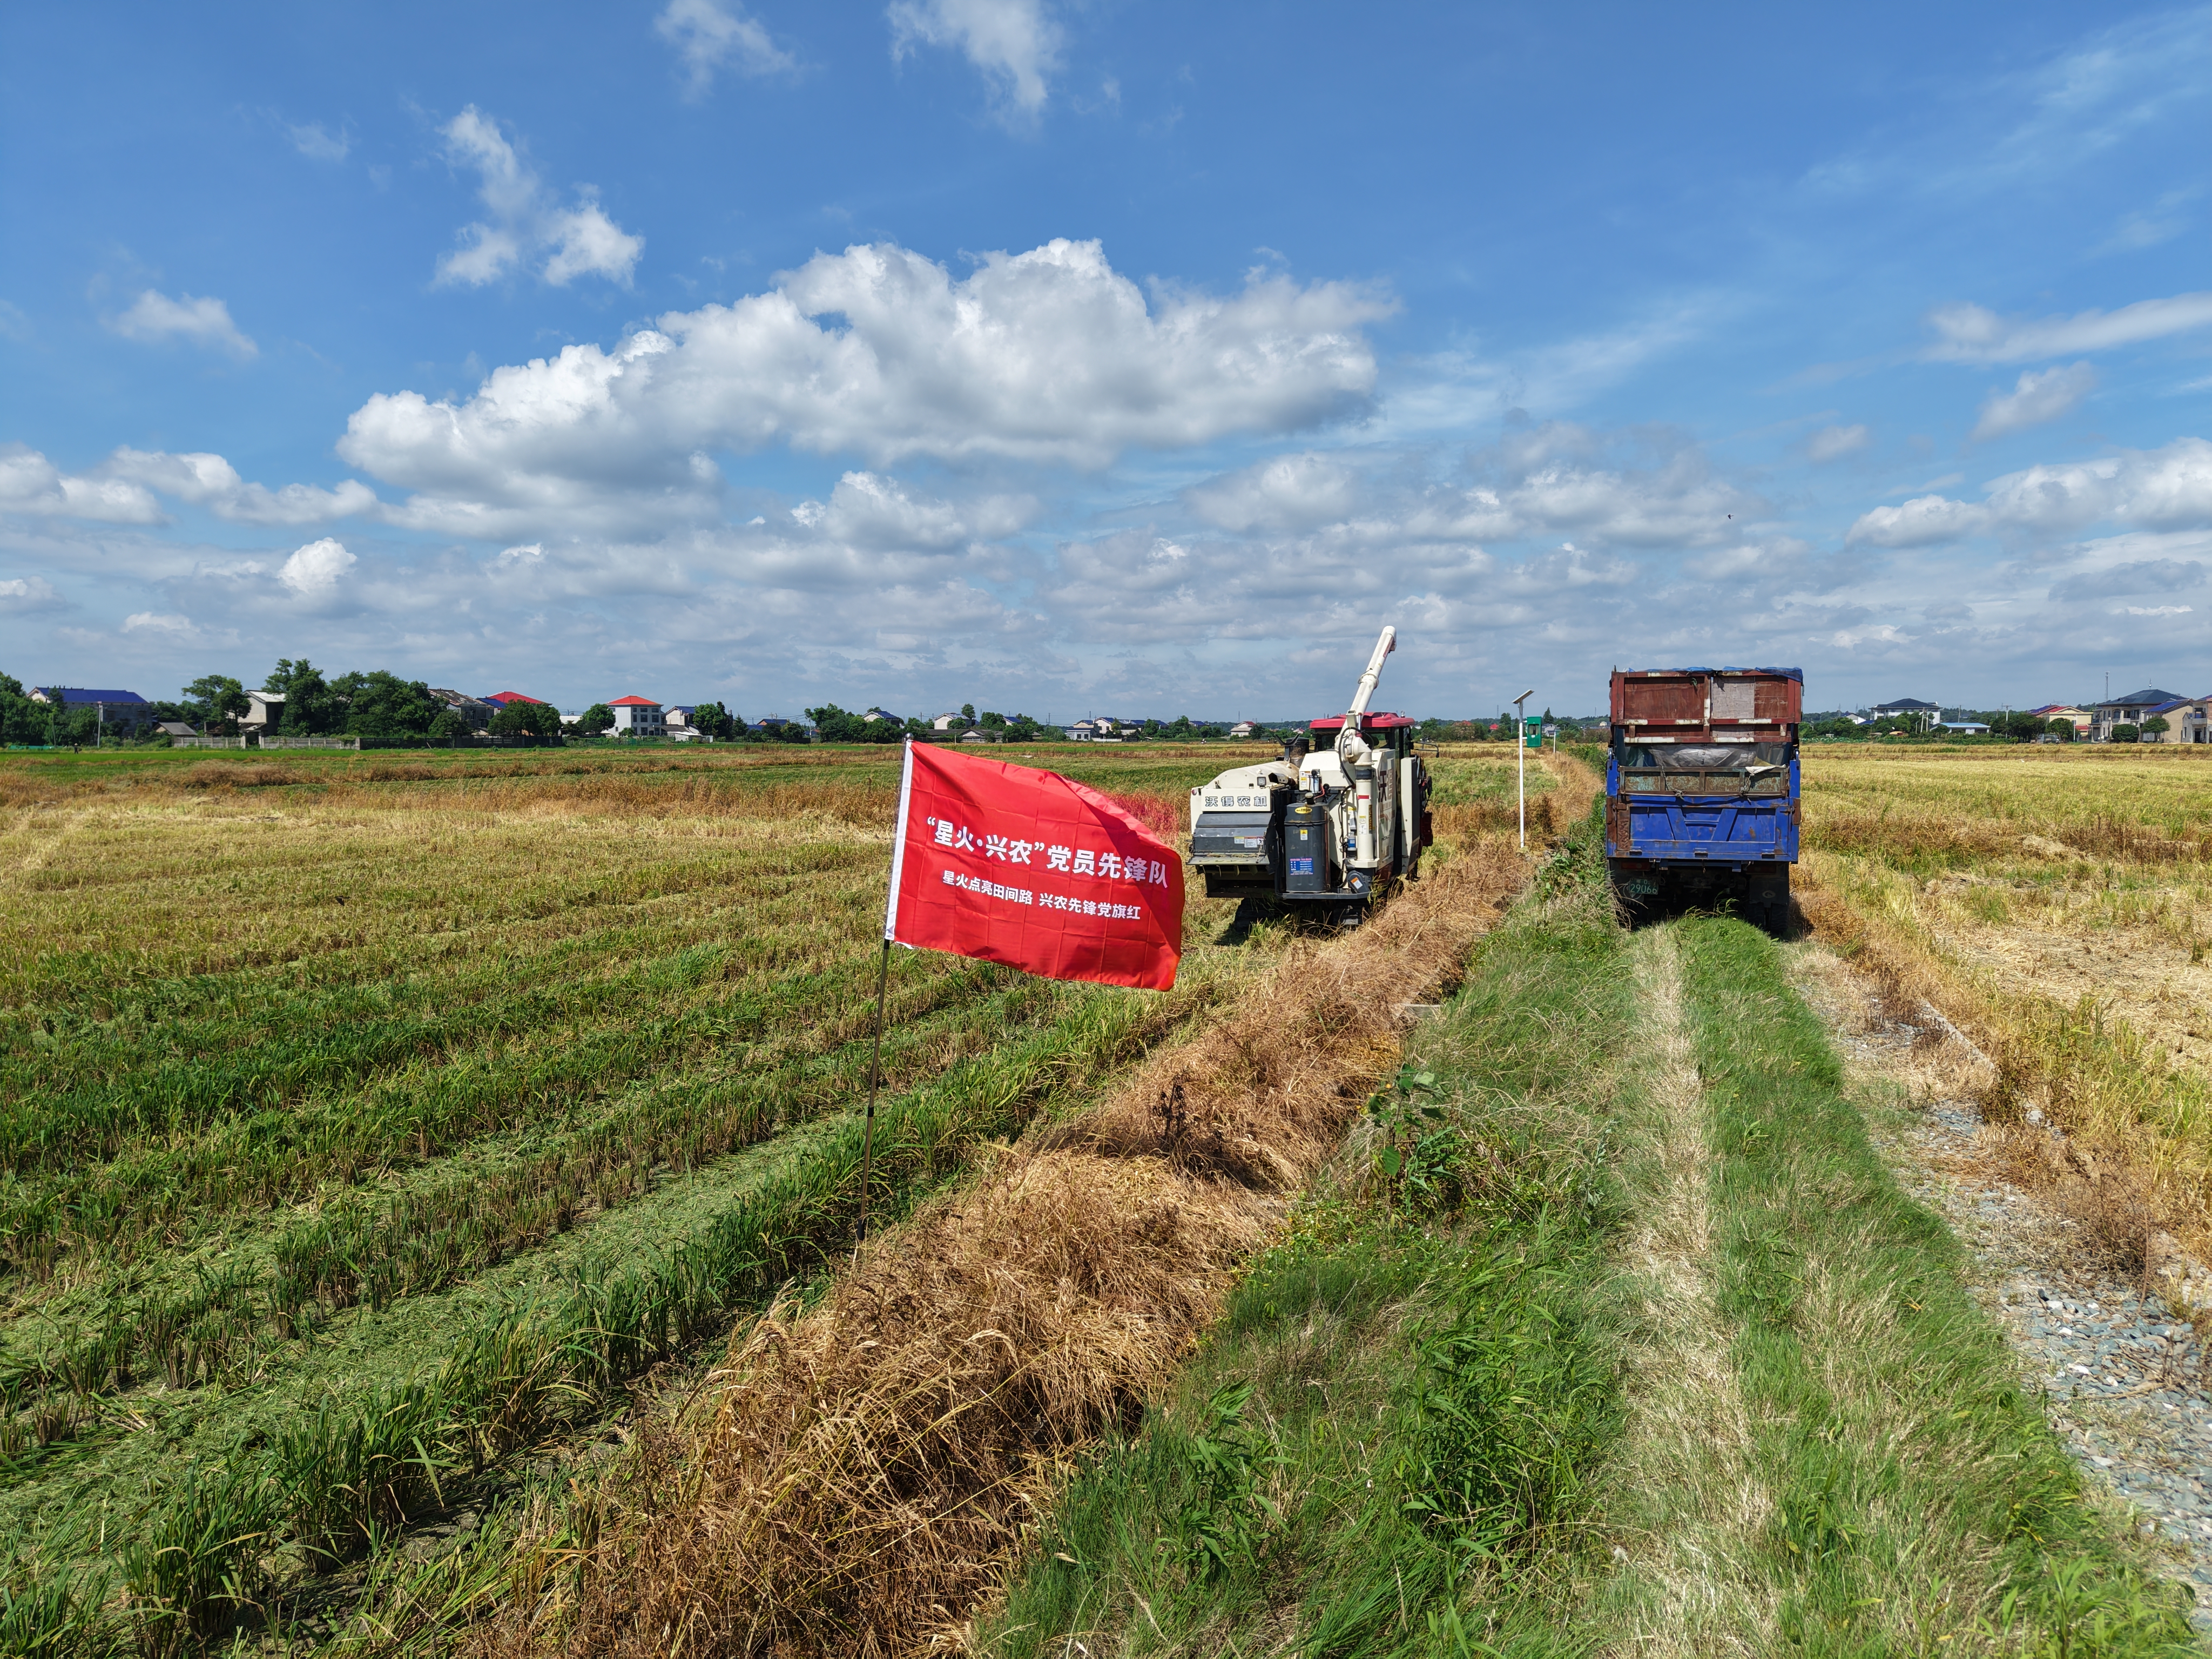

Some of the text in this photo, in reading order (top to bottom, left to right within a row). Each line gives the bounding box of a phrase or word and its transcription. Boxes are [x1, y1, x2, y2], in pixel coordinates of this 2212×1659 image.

[1205, 796, 1267, 806] 沃得农机
[1630, 884, 1657, 894] 29066
[942, 870, 1141, 920] 星火点亮田间路 兴农先锋党旗红
